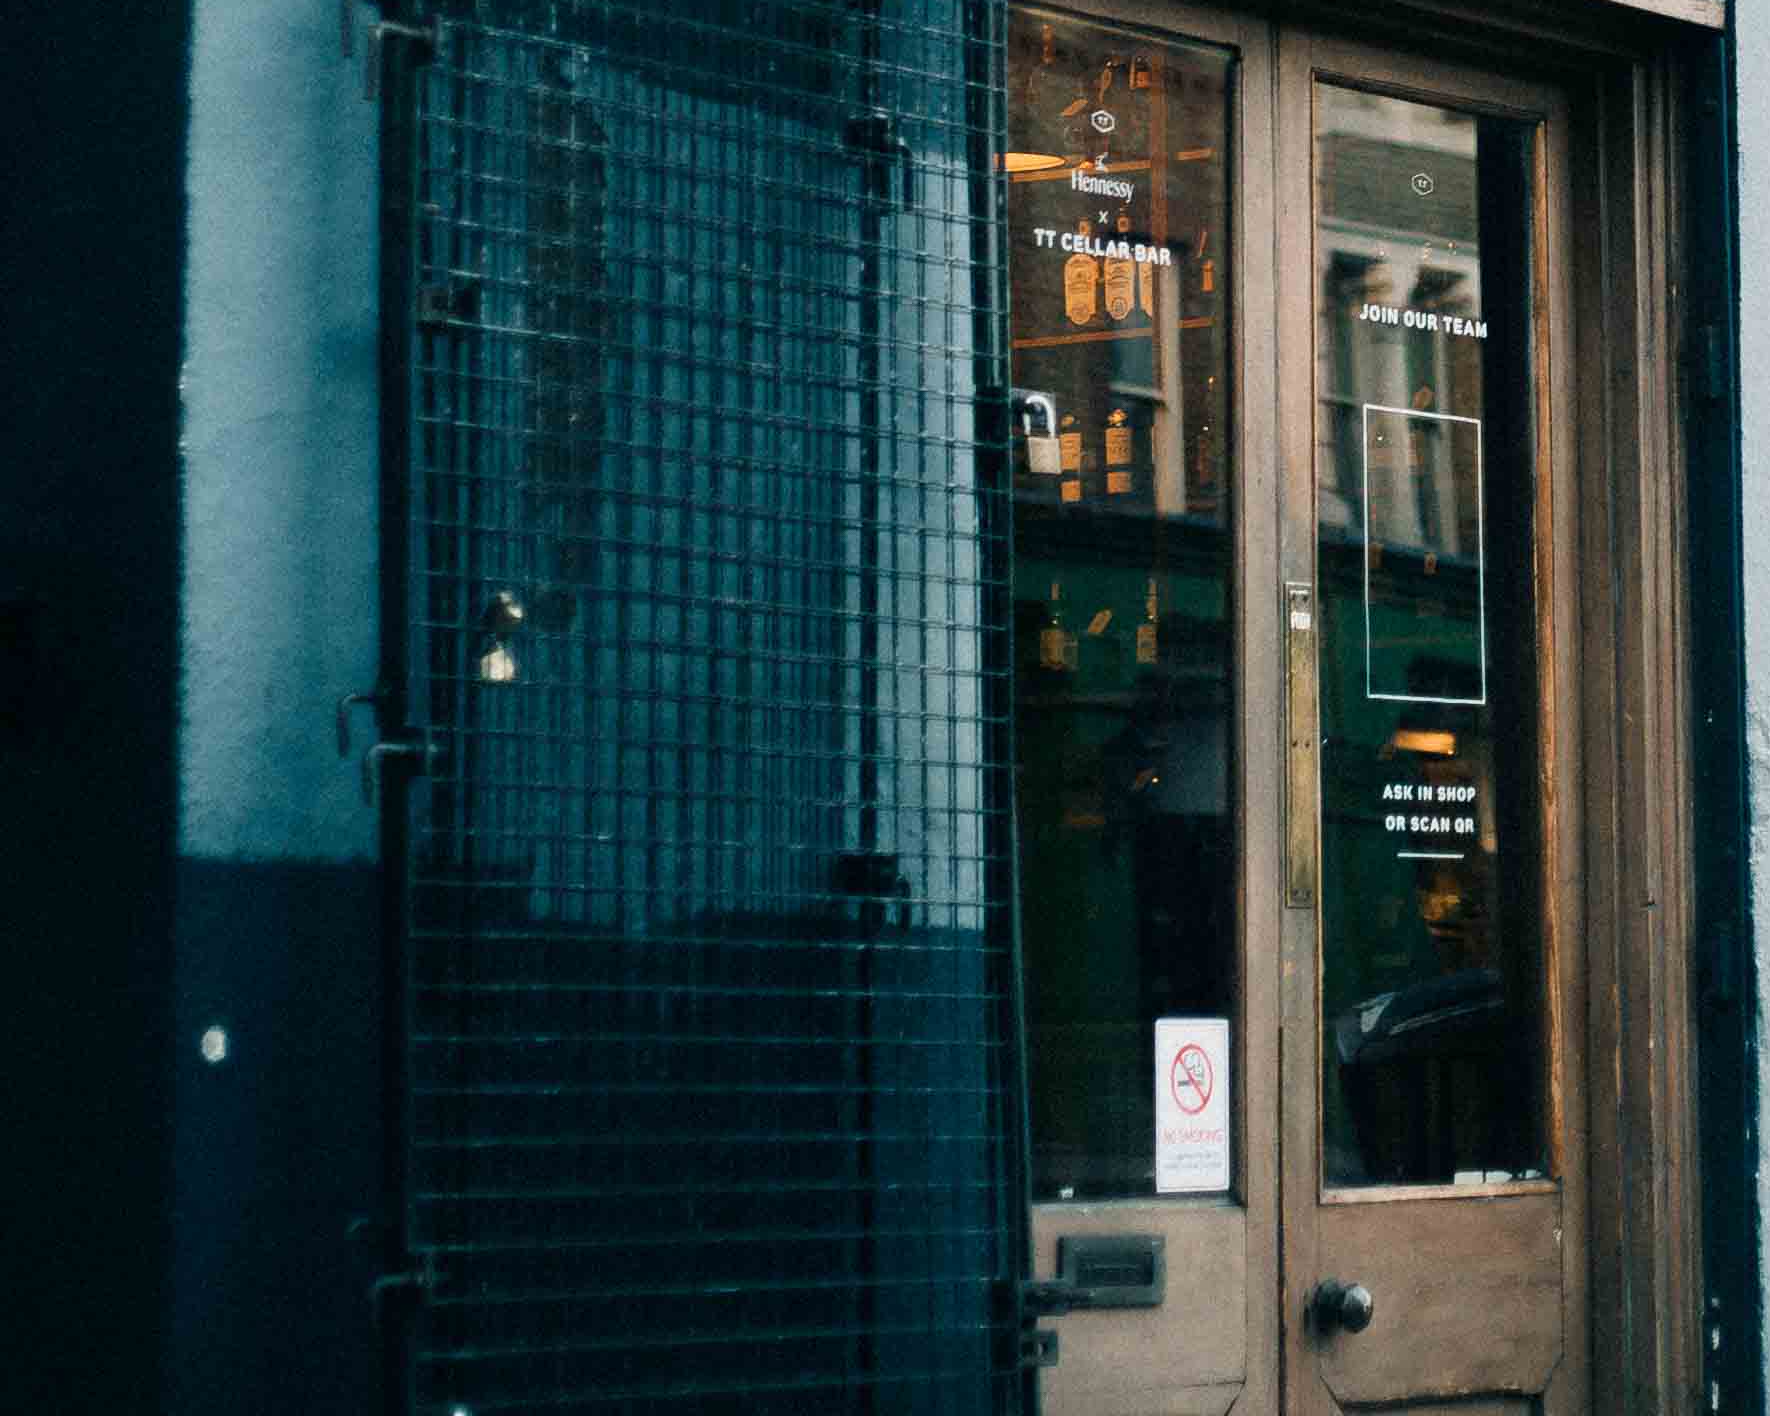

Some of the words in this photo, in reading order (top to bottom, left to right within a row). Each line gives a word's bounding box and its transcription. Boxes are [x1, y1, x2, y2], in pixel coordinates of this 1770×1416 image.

[1071, 169, 1135, 203] Hennessy
[1033, 228, 1056, 248] TT
[1061, 232, 1131, 259] CELLAR
[1135, 244, 1171, 267] BAR
[1359, 304, 1398, 325] JOIN
[1403, 310, 1438, 331] OUR
[1442, 316, 1488, 338] TEAM
[1382, 784, 1414, 800] ASK
[1418, 785, 1432, 801] IN
[1437, 786, 1476, 802] SHOP
[1385, 815, 1406, 831] OR
[1410, 815, 1450, 832] SCAN
[1454, 817, 1474, 833] QR
